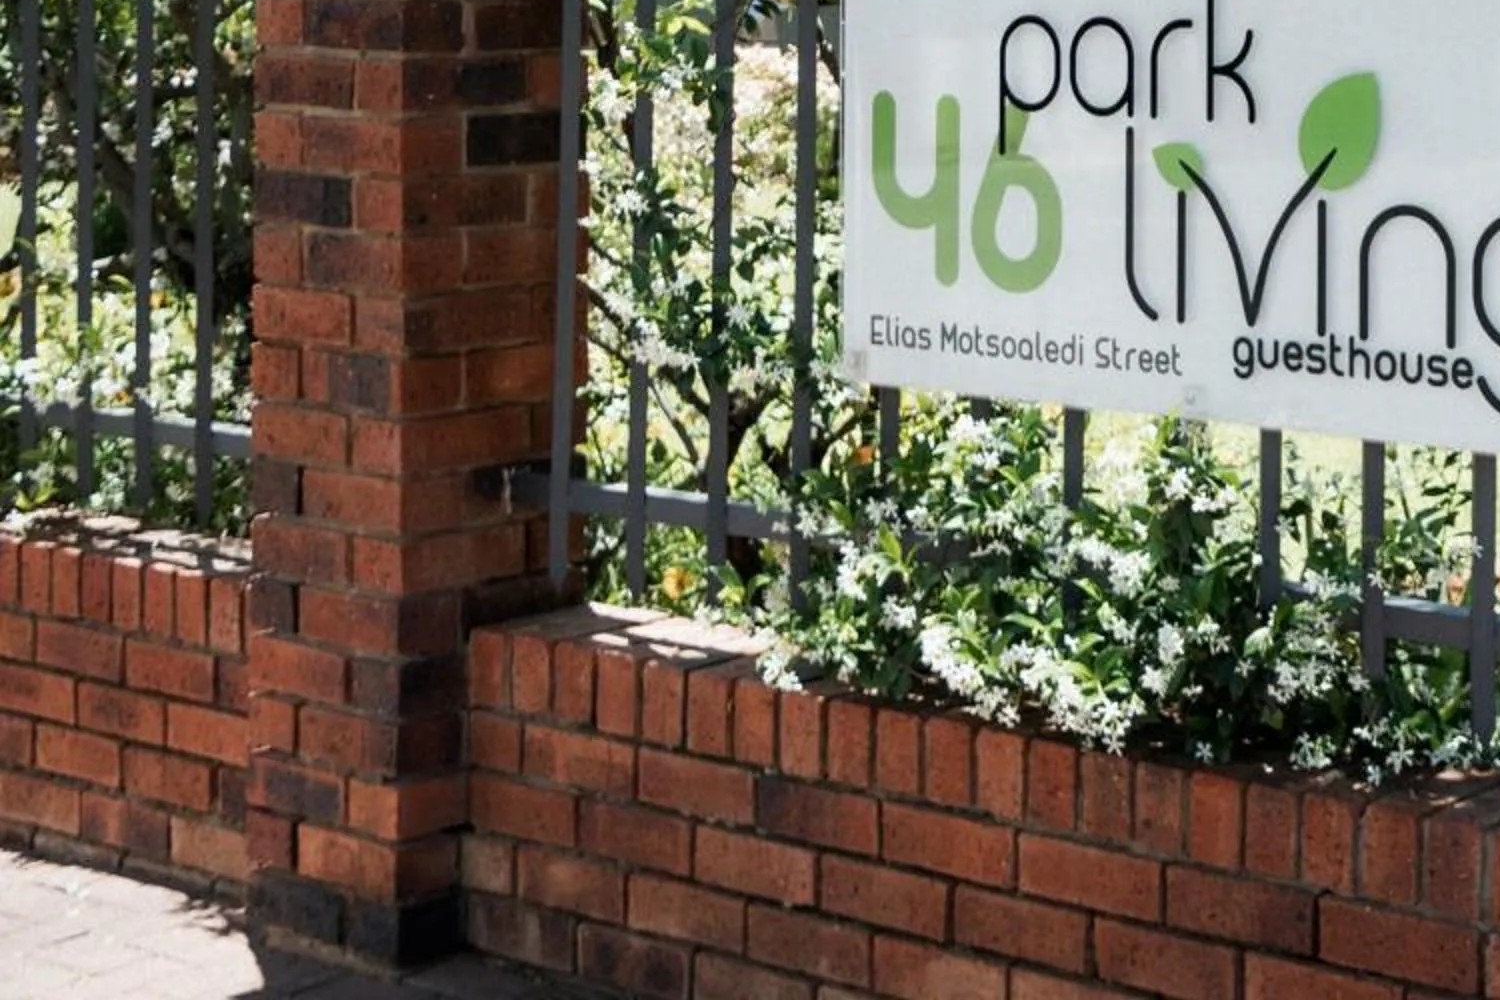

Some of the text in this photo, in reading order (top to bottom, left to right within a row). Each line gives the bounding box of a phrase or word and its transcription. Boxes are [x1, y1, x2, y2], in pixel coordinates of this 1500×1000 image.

[871, 89, 1063, 294] 46
[869, 314, 1183, 377] Elias Motsoaledi Street
[1232, 333, 1476, 389] guesthouse
